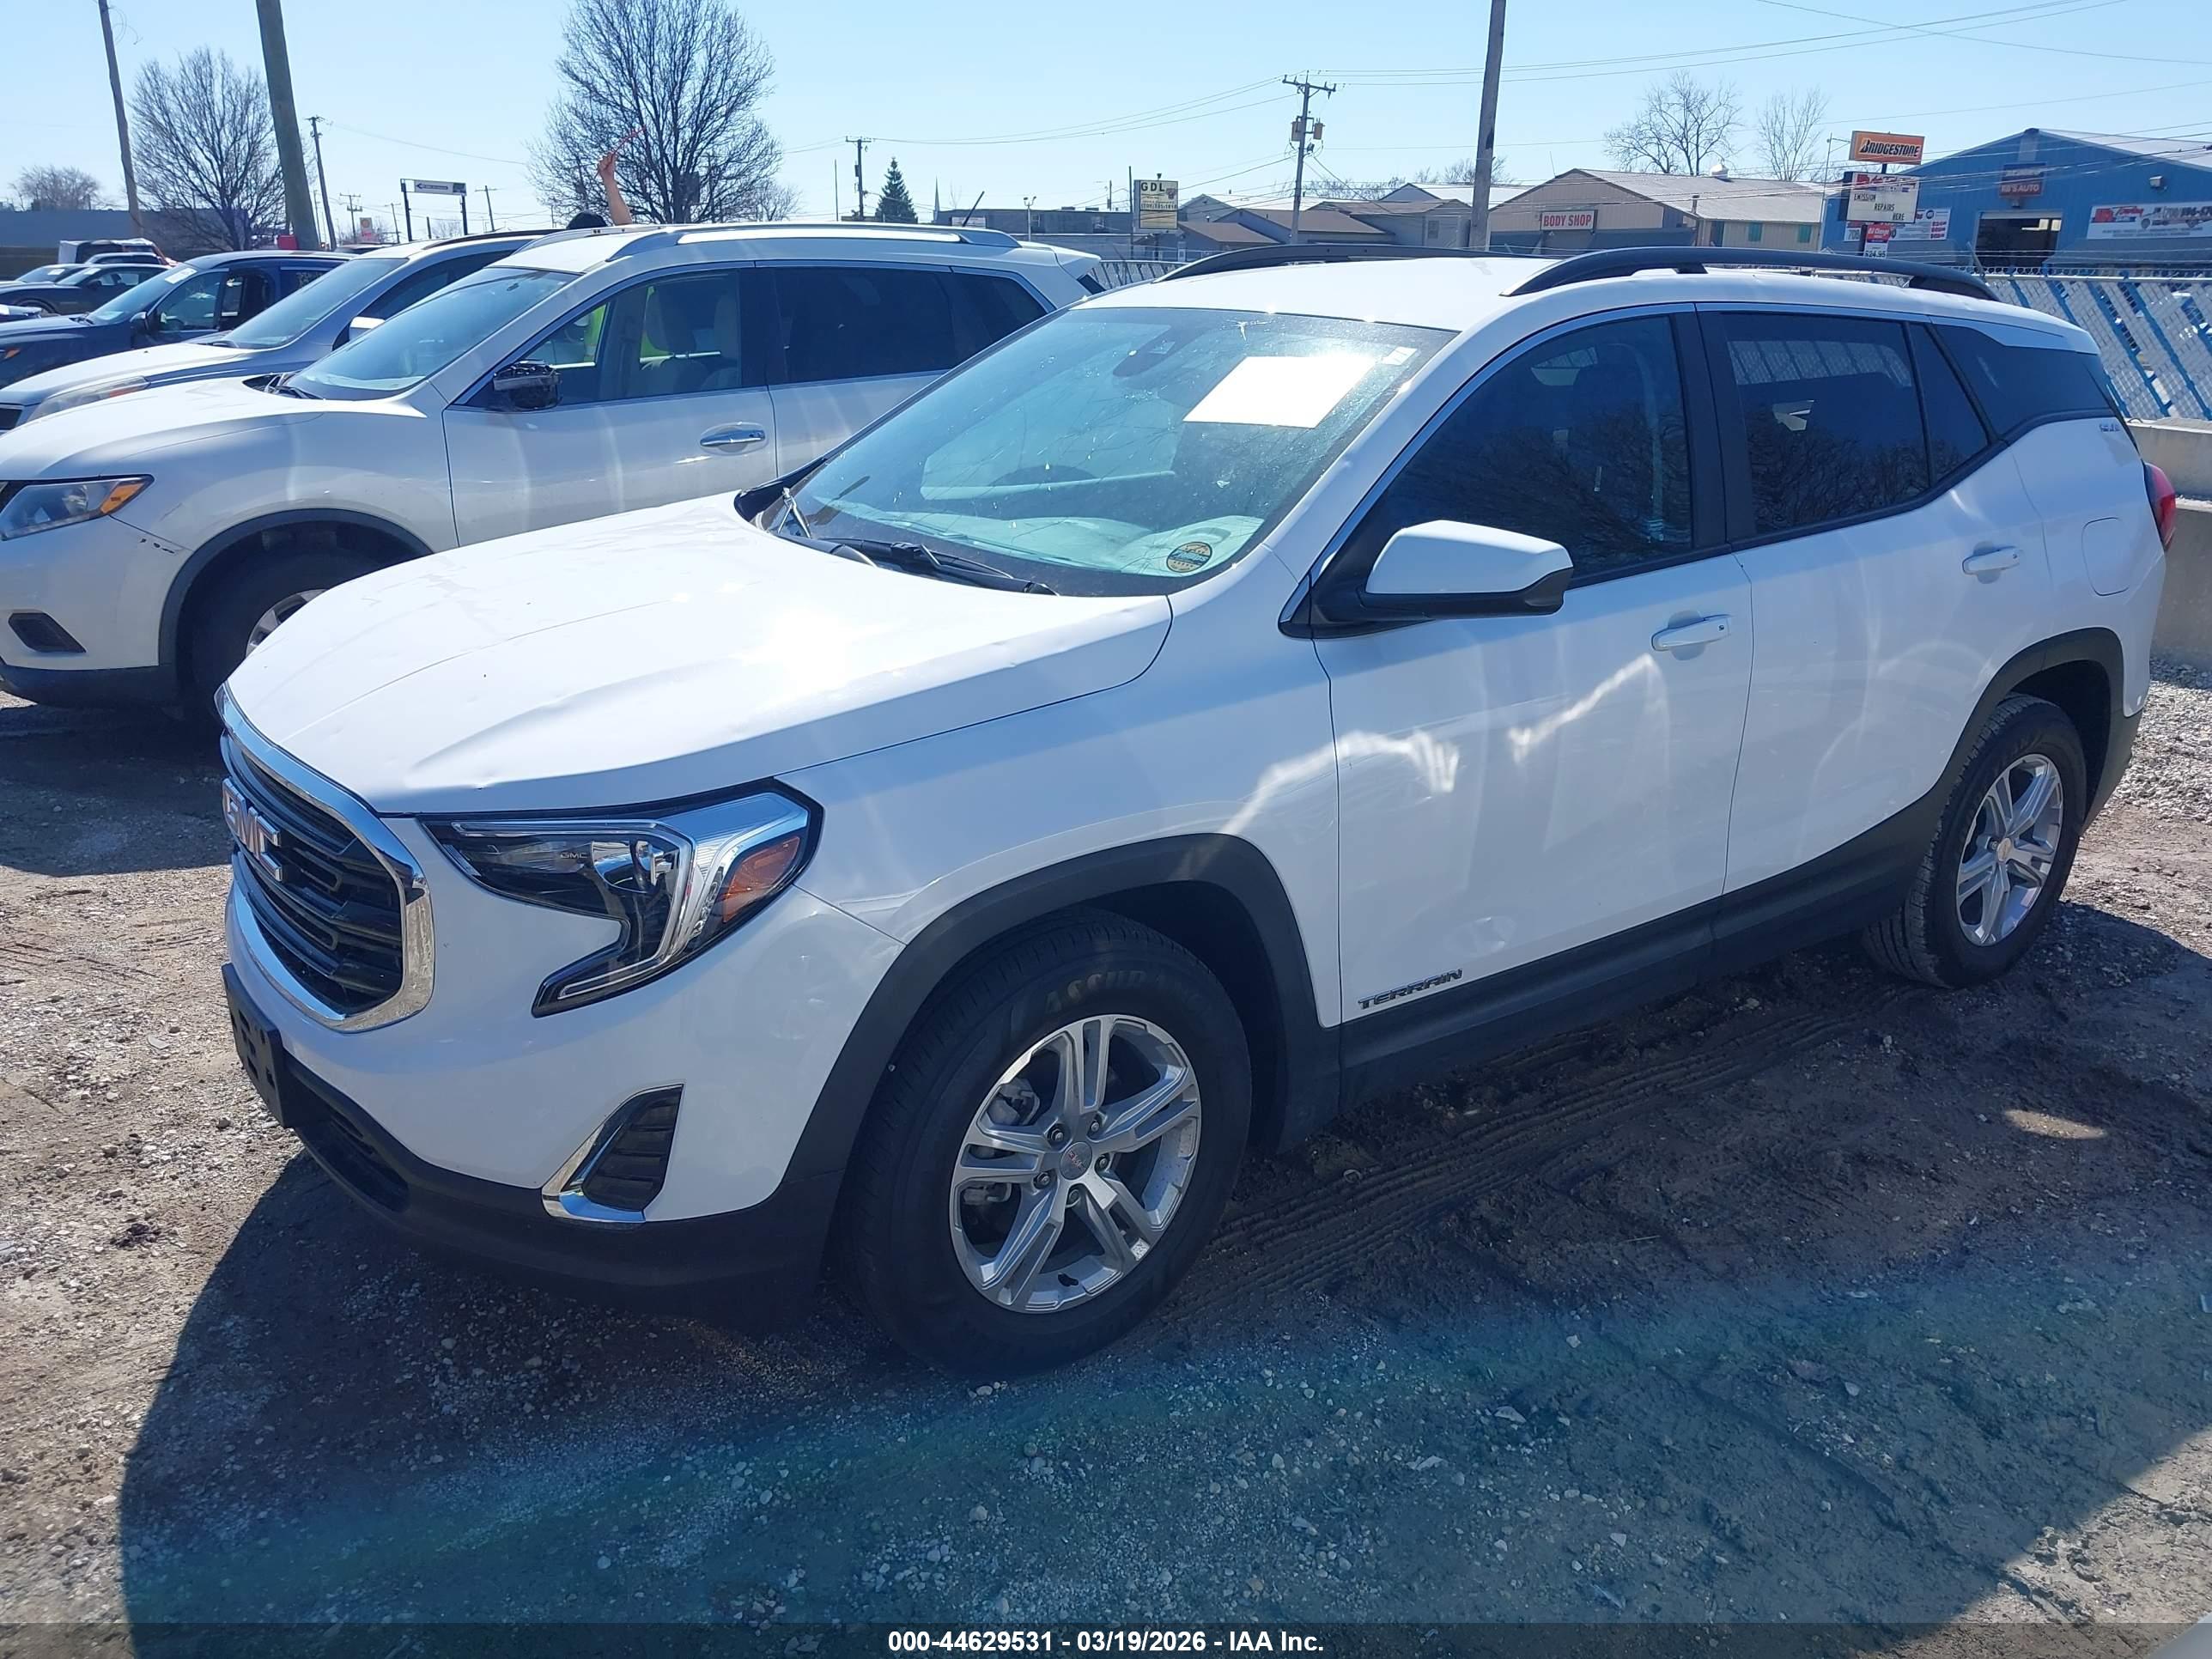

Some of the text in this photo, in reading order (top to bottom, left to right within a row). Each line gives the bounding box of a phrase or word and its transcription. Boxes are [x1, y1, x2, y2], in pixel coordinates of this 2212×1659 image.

[1859, 138, 1921, 157] BRIDGESTONE
[2019, 184, 2039, 192] AUTO
[1875, 203, 1895, 211] REPAIRS
[1543, 214, 1592, 227] BODY SHOP
[1357, 968, 1463, 1010] TERRAIN
